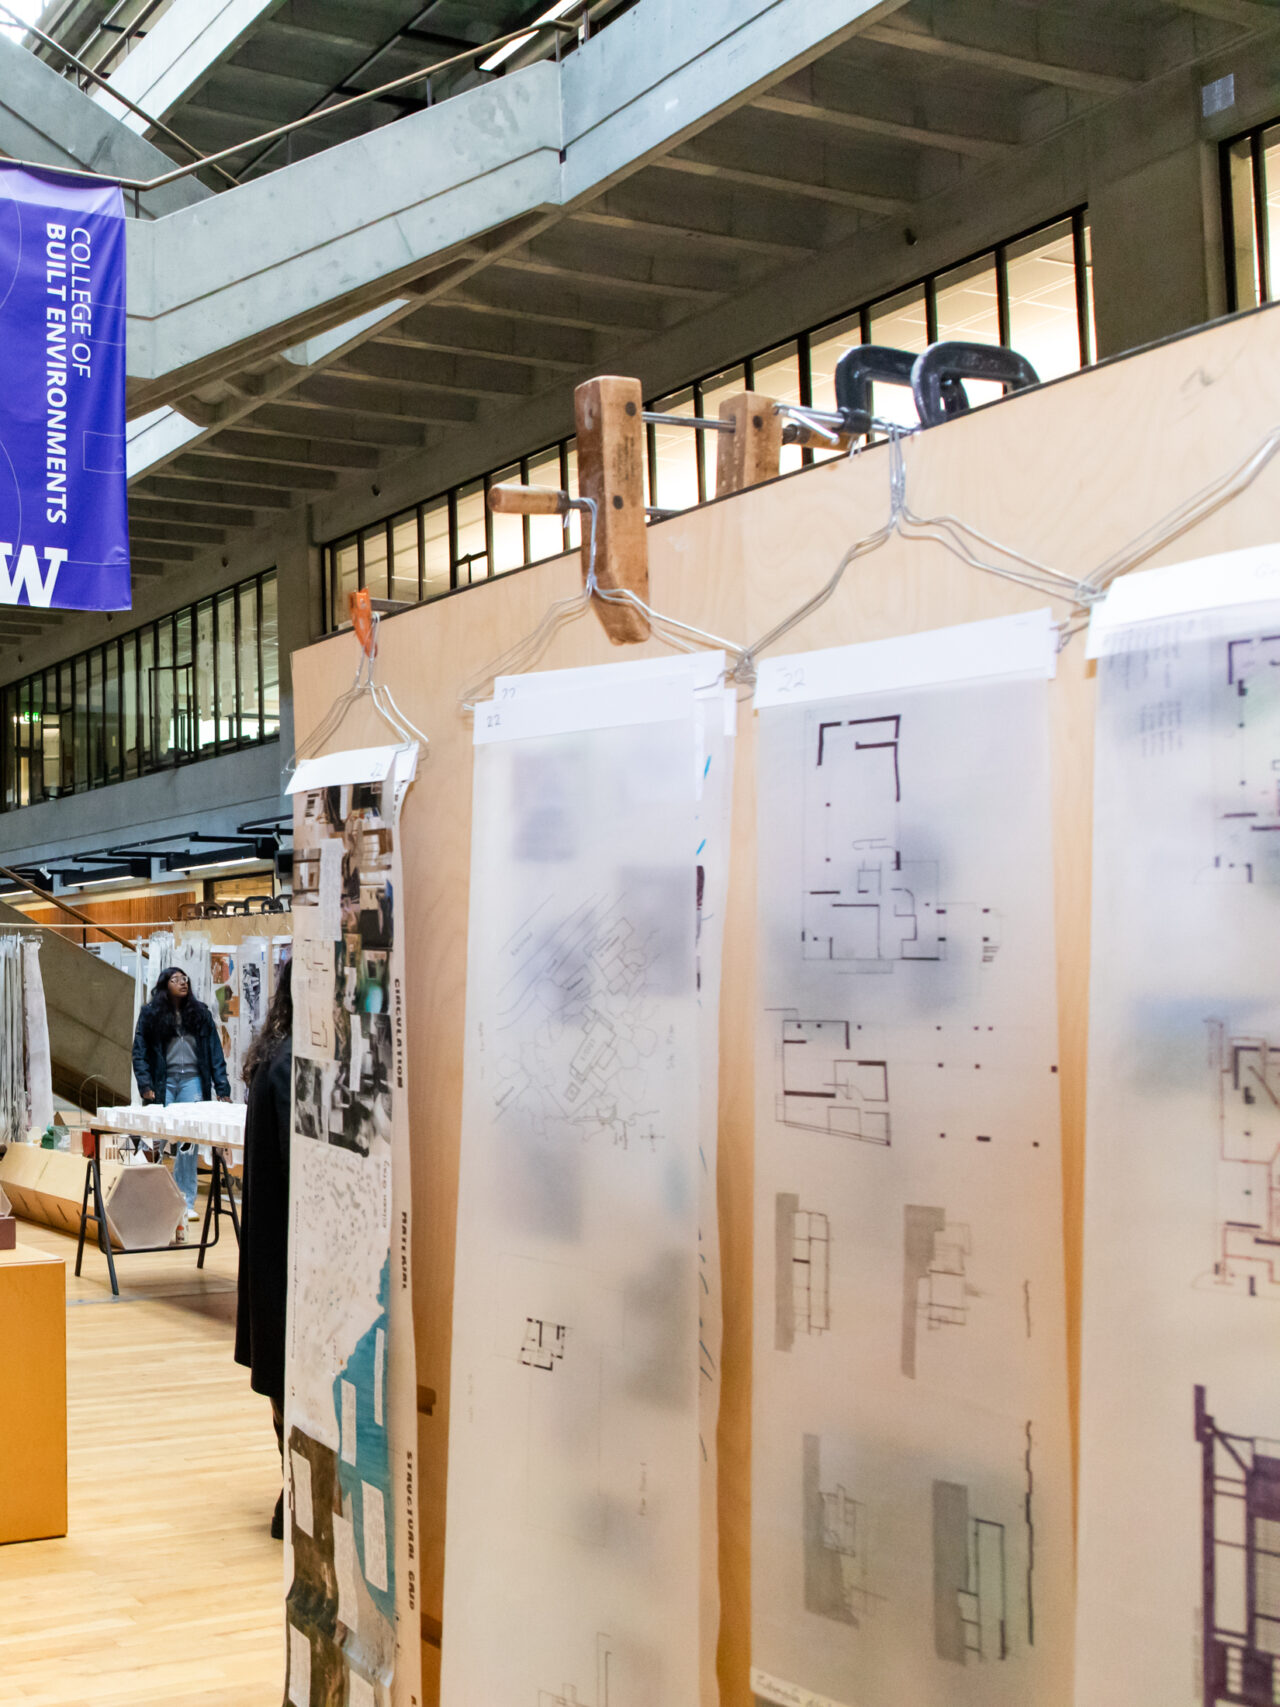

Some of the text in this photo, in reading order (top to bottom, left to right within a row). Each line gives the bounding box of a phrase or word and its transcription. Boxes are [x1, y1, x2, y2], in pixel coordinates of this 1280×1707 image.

[46, 222, 67, 525] BUILT ENVIRONMENTS
[71, 227, 92, 379] COLLEGE OF
[395, 978, 404, 1089] CIRCULATION
[406, 1450, 416, 1611] STRUCTURAL GRID
